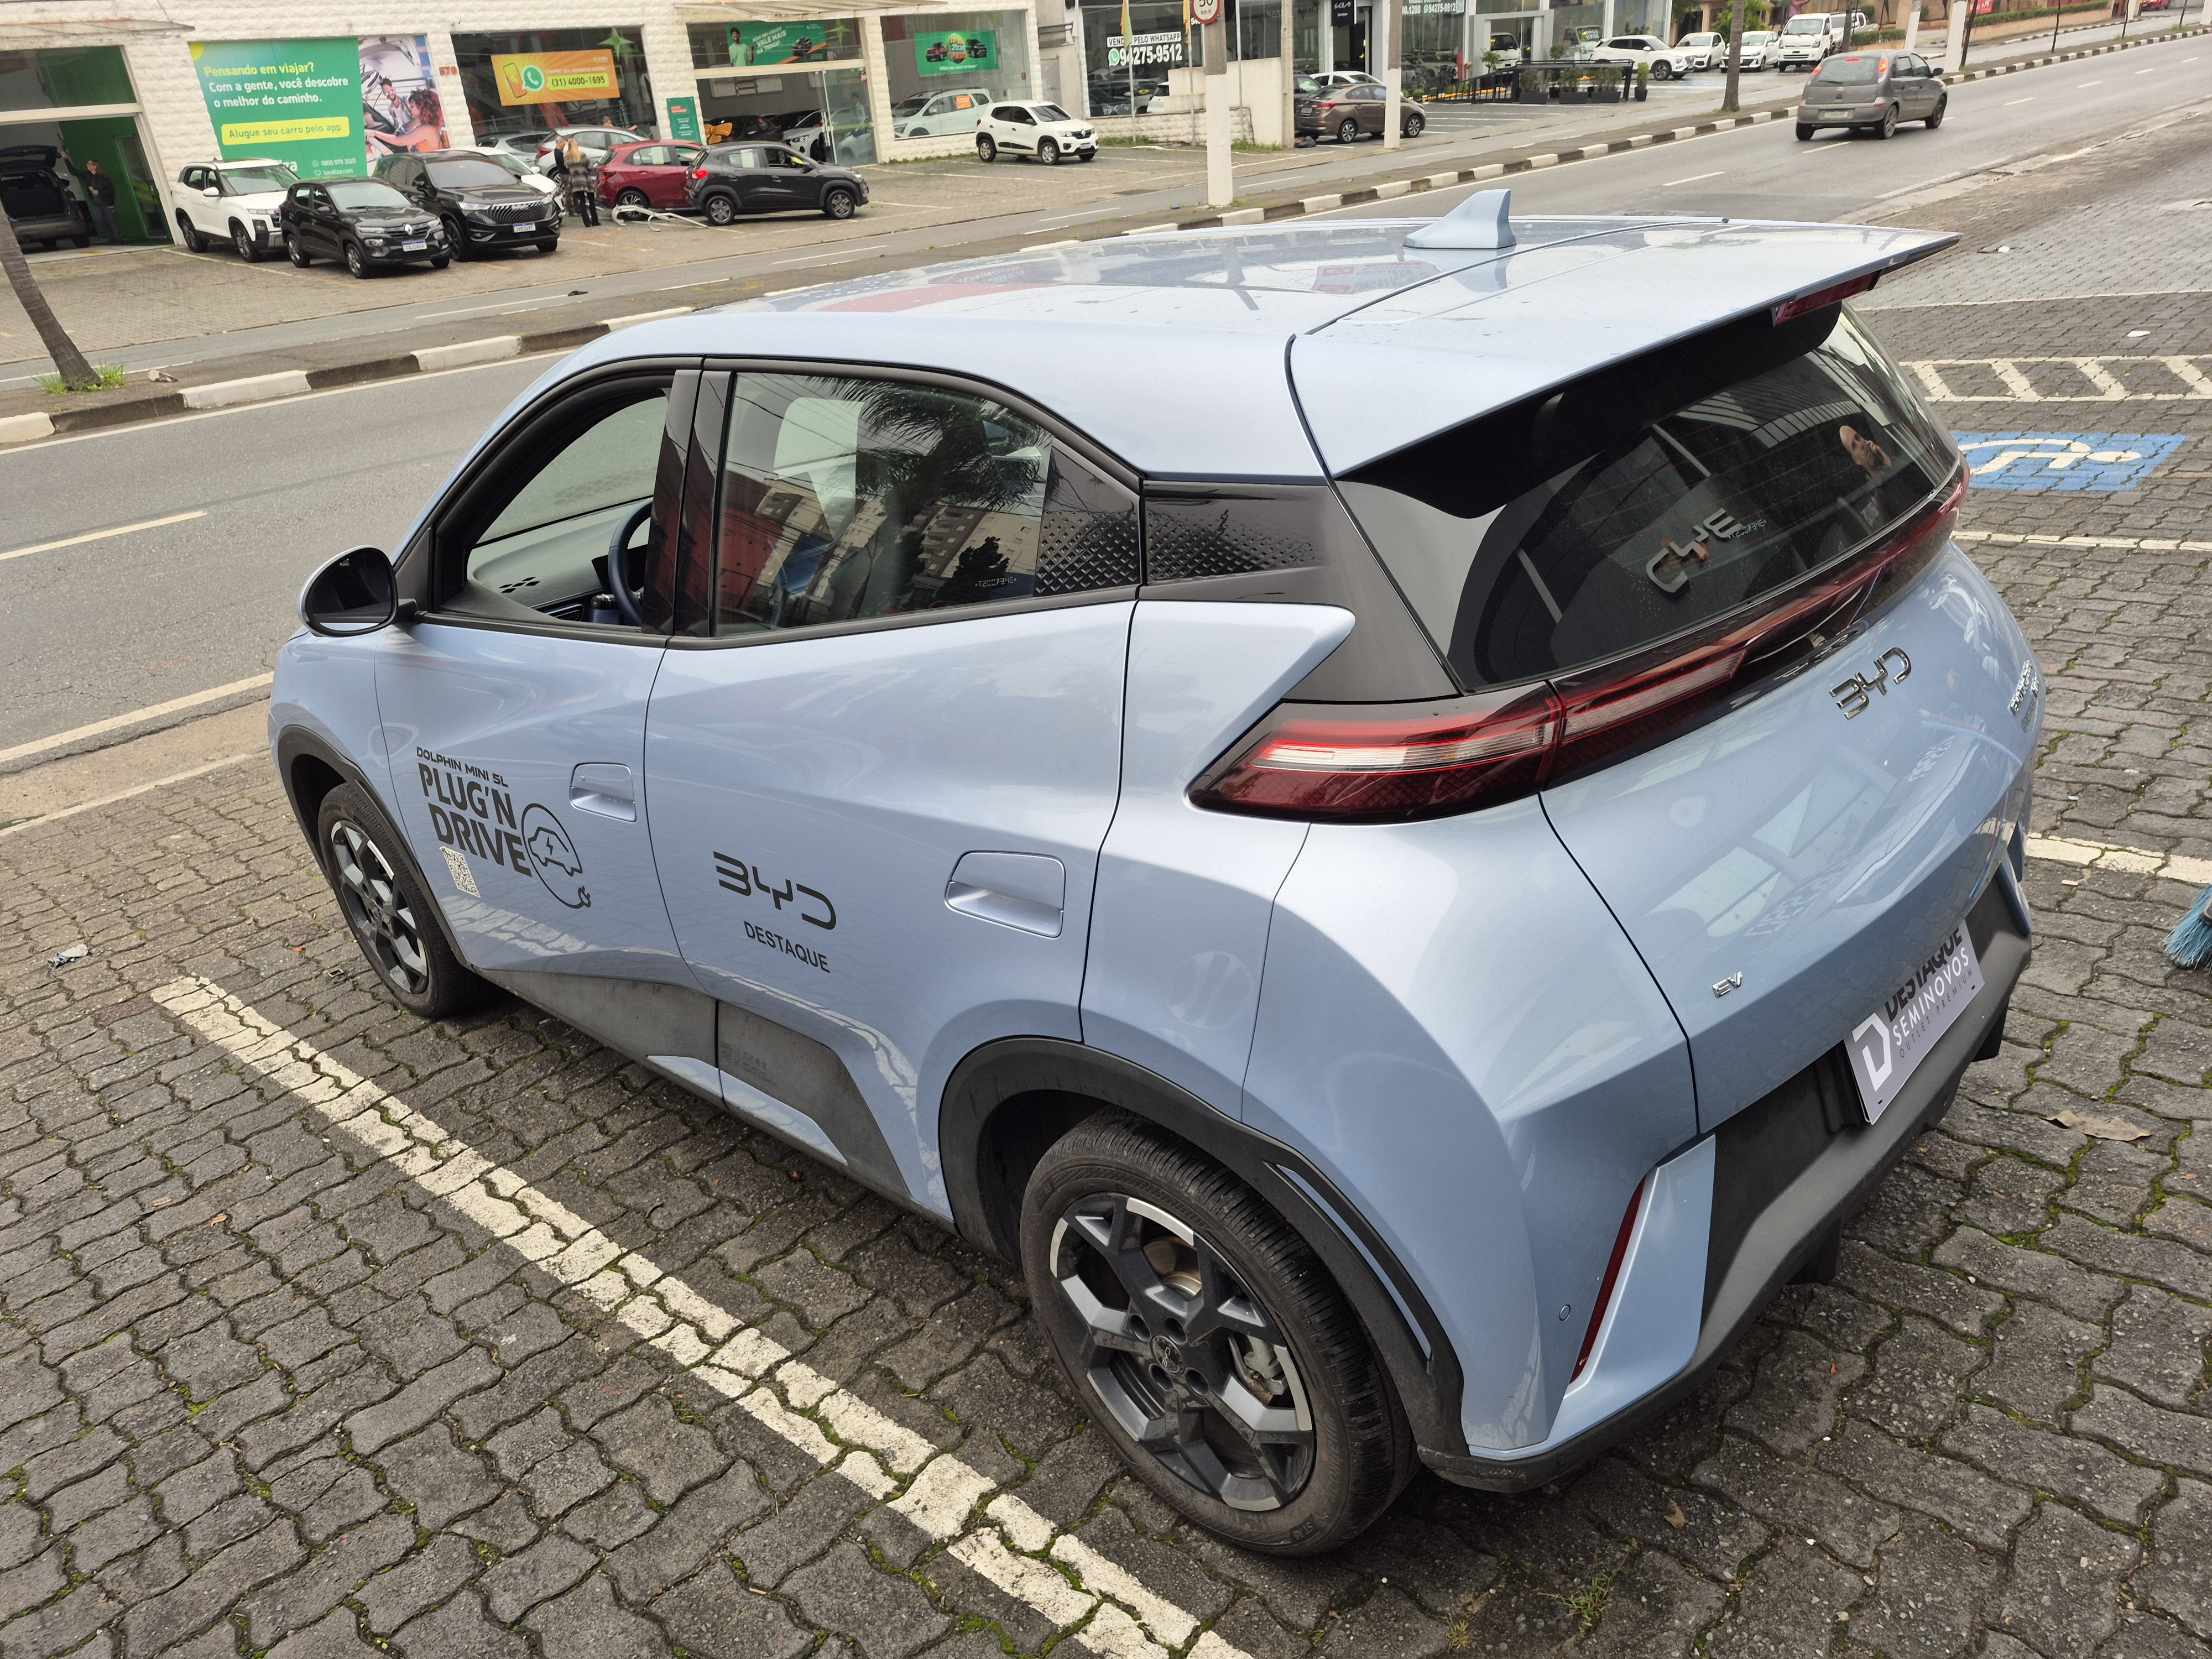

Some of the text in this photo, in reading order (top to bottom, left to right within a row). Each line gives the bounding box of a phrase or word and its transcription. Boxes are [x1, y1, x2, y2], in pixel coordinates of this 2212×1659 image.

[1334, 1, 1351, 9] KIA
[771, 29, 786, 41] MAIS
[1134, 35, 1149, 44] PELO
[1150, 33, 1180, 43] WHATSAPP
[951, 52, 967, 60] PAGO
[1119, 43, 1183, 66] 94275-9512
[204, 62, 314, 77] Pensando em viajar?
[551, 77, 566, 87] (31)
[209, 76, 348, 93] Com a gente, você descobre
[214, 93, 322, 108] o melhor do caminho.
[229, 124, 341, 139] Alugue seu carro pelo app
[1829, 646, 1912, 720] BYD
[416, 747, 462, 771] DOLPHIN
[465, 763, 489, 781] MINI
[418, 763, 517, 830] PLUG'N
[428, 803, 533, 877] DRIVE
[713, 851, 836, 930] BYD
[744, 921, 830, 973] DESTAQUE
[1711, 971, 1743, 999] EV
[1885, 927, 1963, 1022] DESTAQUE
[1893, 947, 1969, 1046] SEMINOVOS
[1900, 968, 1973, 1058] OUTLET PREMIUM
